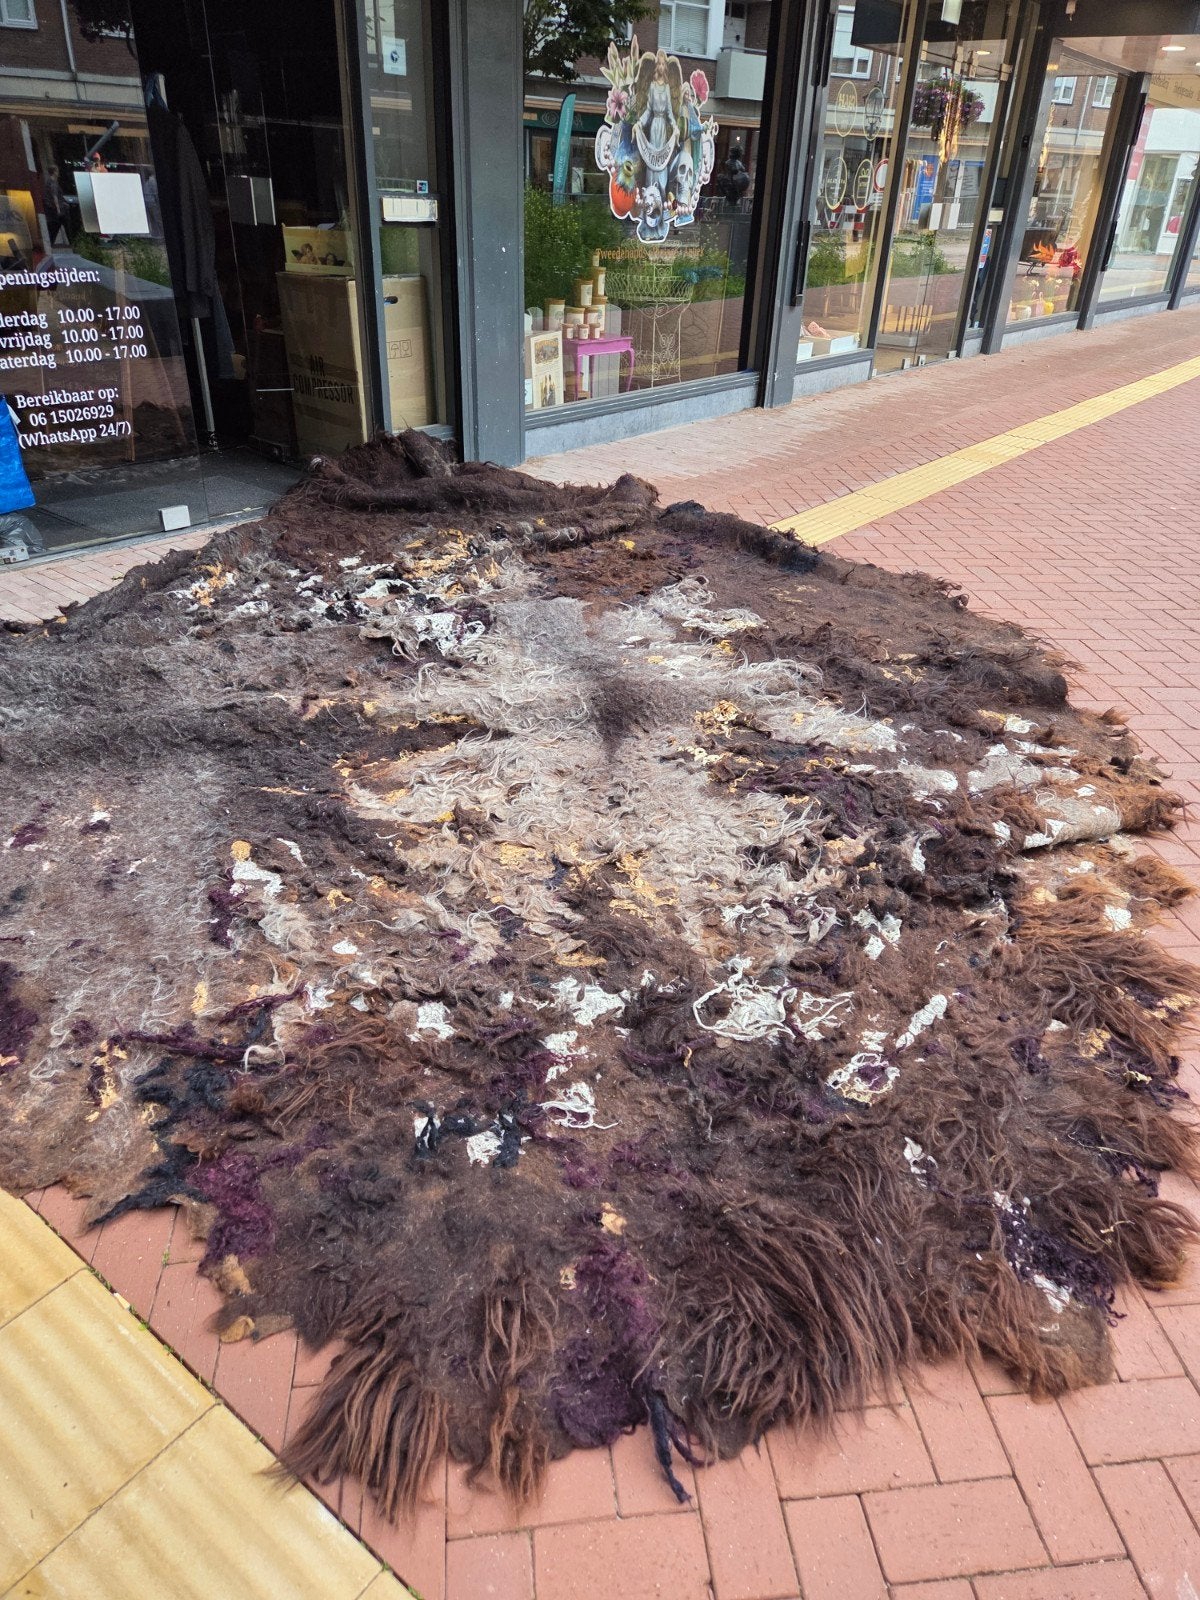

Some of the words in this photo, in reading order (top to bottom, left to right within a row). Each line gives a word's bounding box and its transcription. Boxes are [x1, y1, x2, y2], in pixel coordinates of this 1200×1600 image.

[57, 308, 95, 324] 10.00
[105, 306, 141, 321] 17.00
[0, 332, 53, 351] vrijdag
[61, 328, 99, 344] 10.00
[109, 325, 144, 340] 17.00
[65, 348, 102, 363] 10.00
[112, 344, 147, 359] 17.00
[310, 354, 325, 377] AIR
[15, 389, 95, 409] Bereikbaar
[98, 387, 119, 403] op:
[294, 373, 355, 404] COMPRESSOR
[29, 412, 48, 427] 06
[50, 404, 114, 424] 15026929
[18, 428, 97, 449] (WhatsApp
[99, 420, 132, 437] 24/7)
